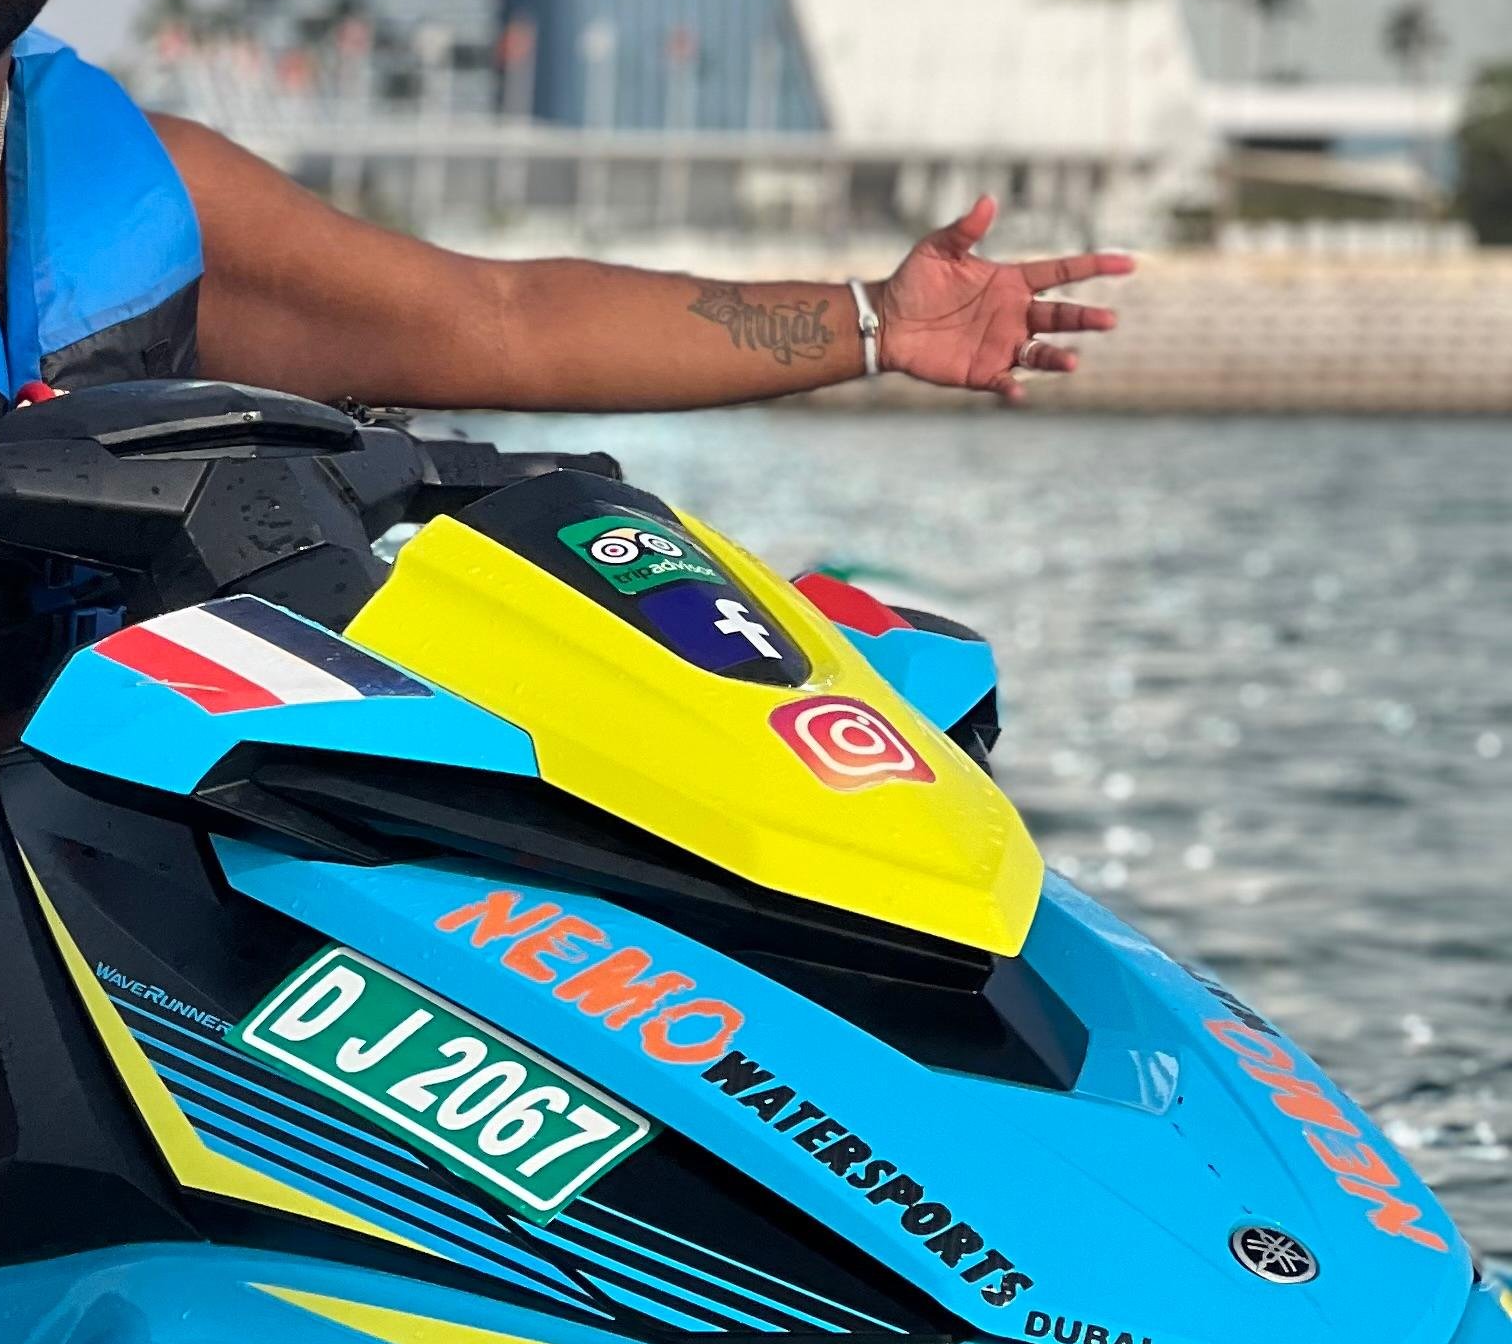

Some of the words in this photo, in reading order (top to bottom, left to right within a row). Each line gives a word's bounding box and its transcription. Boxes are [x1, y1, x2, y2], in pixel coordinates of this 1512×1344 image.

[714, 598, 784, 660] f
[386, 1037, 620, 1180] 2067
[434, 890, 745, 1064] NEMO
[700, 1050, 1035, 1307] WATERSPORTS
